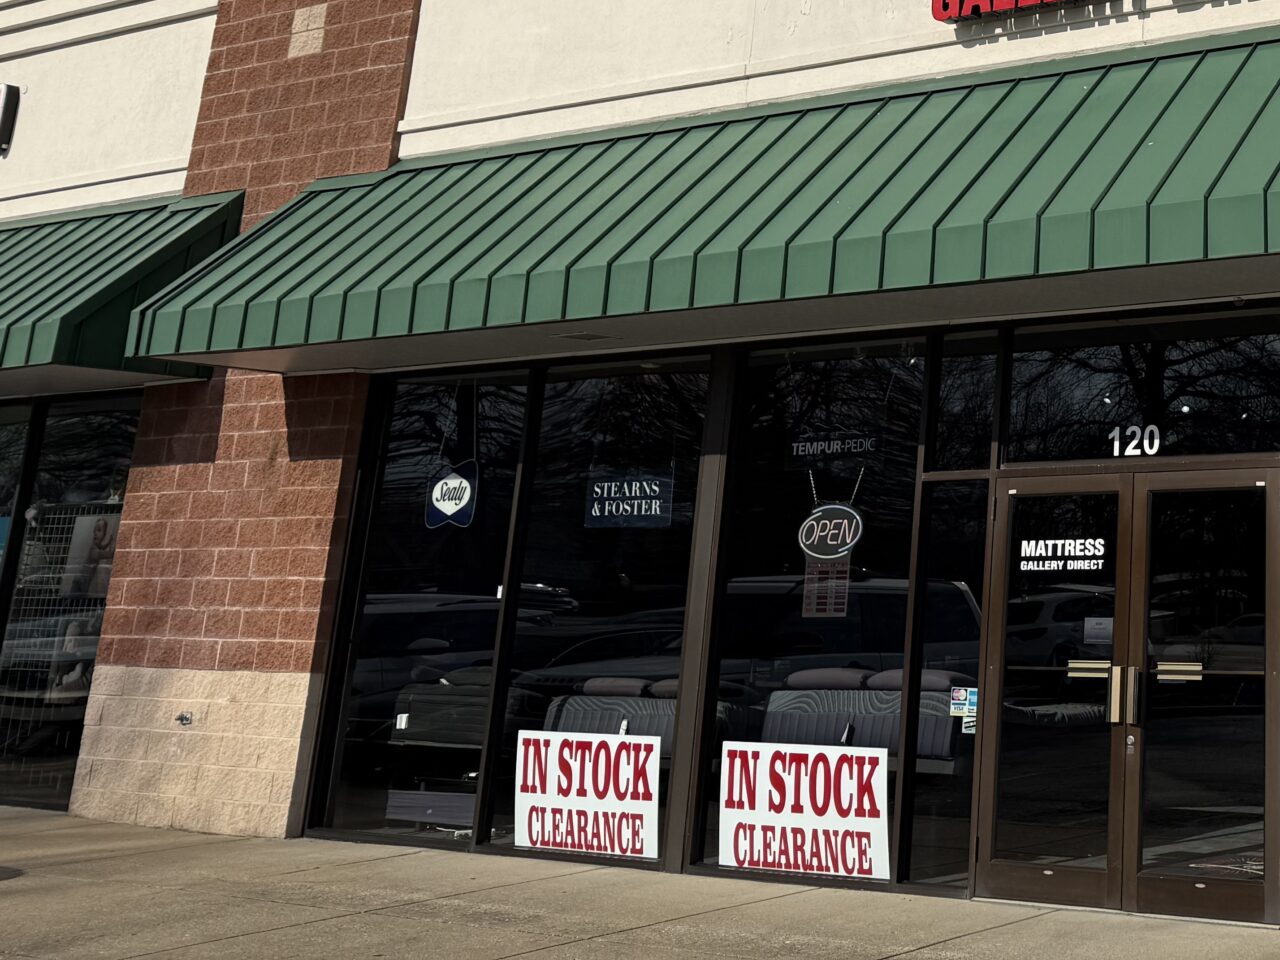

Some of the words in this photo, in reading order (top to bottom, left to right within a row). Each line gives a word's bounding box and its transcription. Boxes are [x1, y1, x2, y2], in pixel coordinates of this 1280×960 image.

[792, 438, 876, 456] TEMPUR-PEDIC
[1108, 424, 1160, 457] 120
[435, 481, 467, 505] Sealy
[593, 481, 660, 498] STEARNS
[591, 504, 601, 517] &
[604, 500, 661, 516] FOSTER
[802, 519, 857, 545] OPEN
[1021, 539, 1105, 557] MATTRESS
[1020, 560, 1063, 571] GALLERY
[1067, 559, 1104, 570] DIRECT
[520, 738, 550, 794] IN
[557, 738, 654, 801] STOCK
[725, 749, 760, 810] IN
[768, 750, 880, 819] STOCK
[527, 805, 644, 855] CLEARANCE
[733, 822, 873, 876] CLEARANCE
